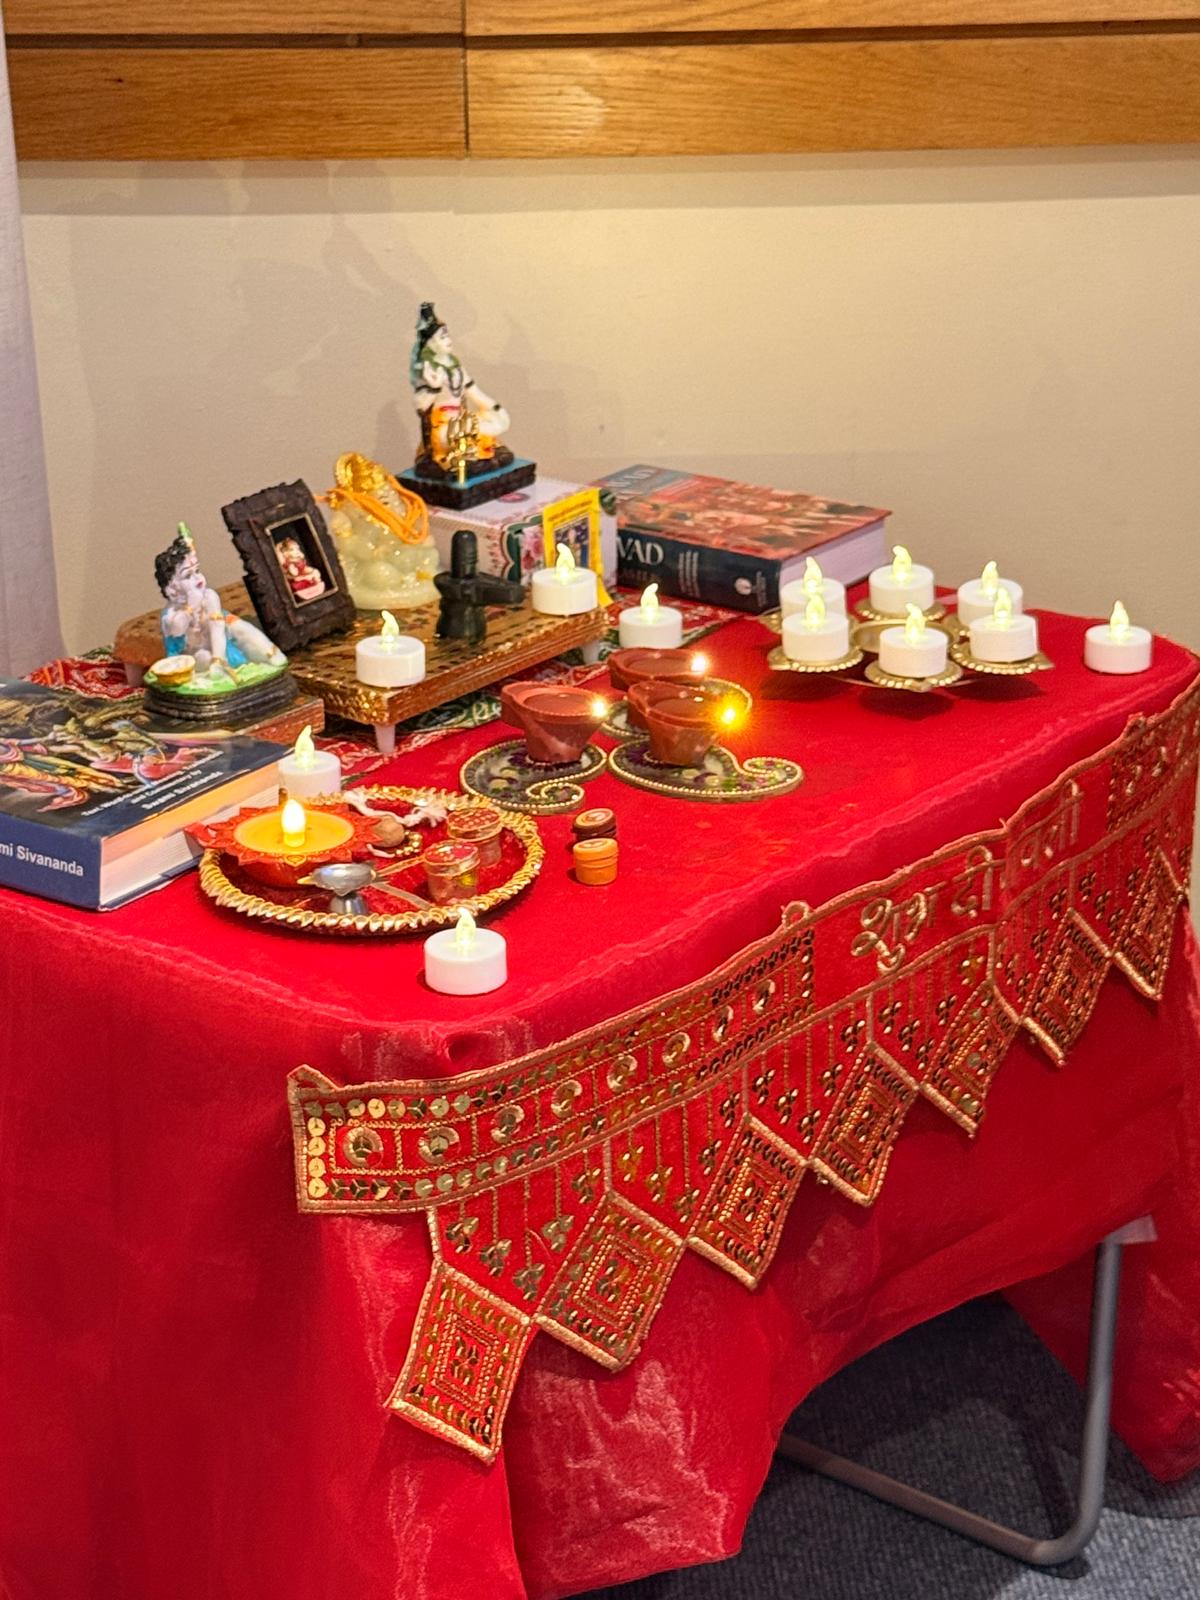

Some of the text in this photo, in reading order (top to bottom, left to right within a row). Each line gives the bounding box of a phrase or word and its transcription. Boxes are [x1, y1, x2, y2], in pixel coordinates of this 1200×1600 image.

[616, 536, 664, 566] VAD
[0, 843, 84, 877] mi Sivananda
